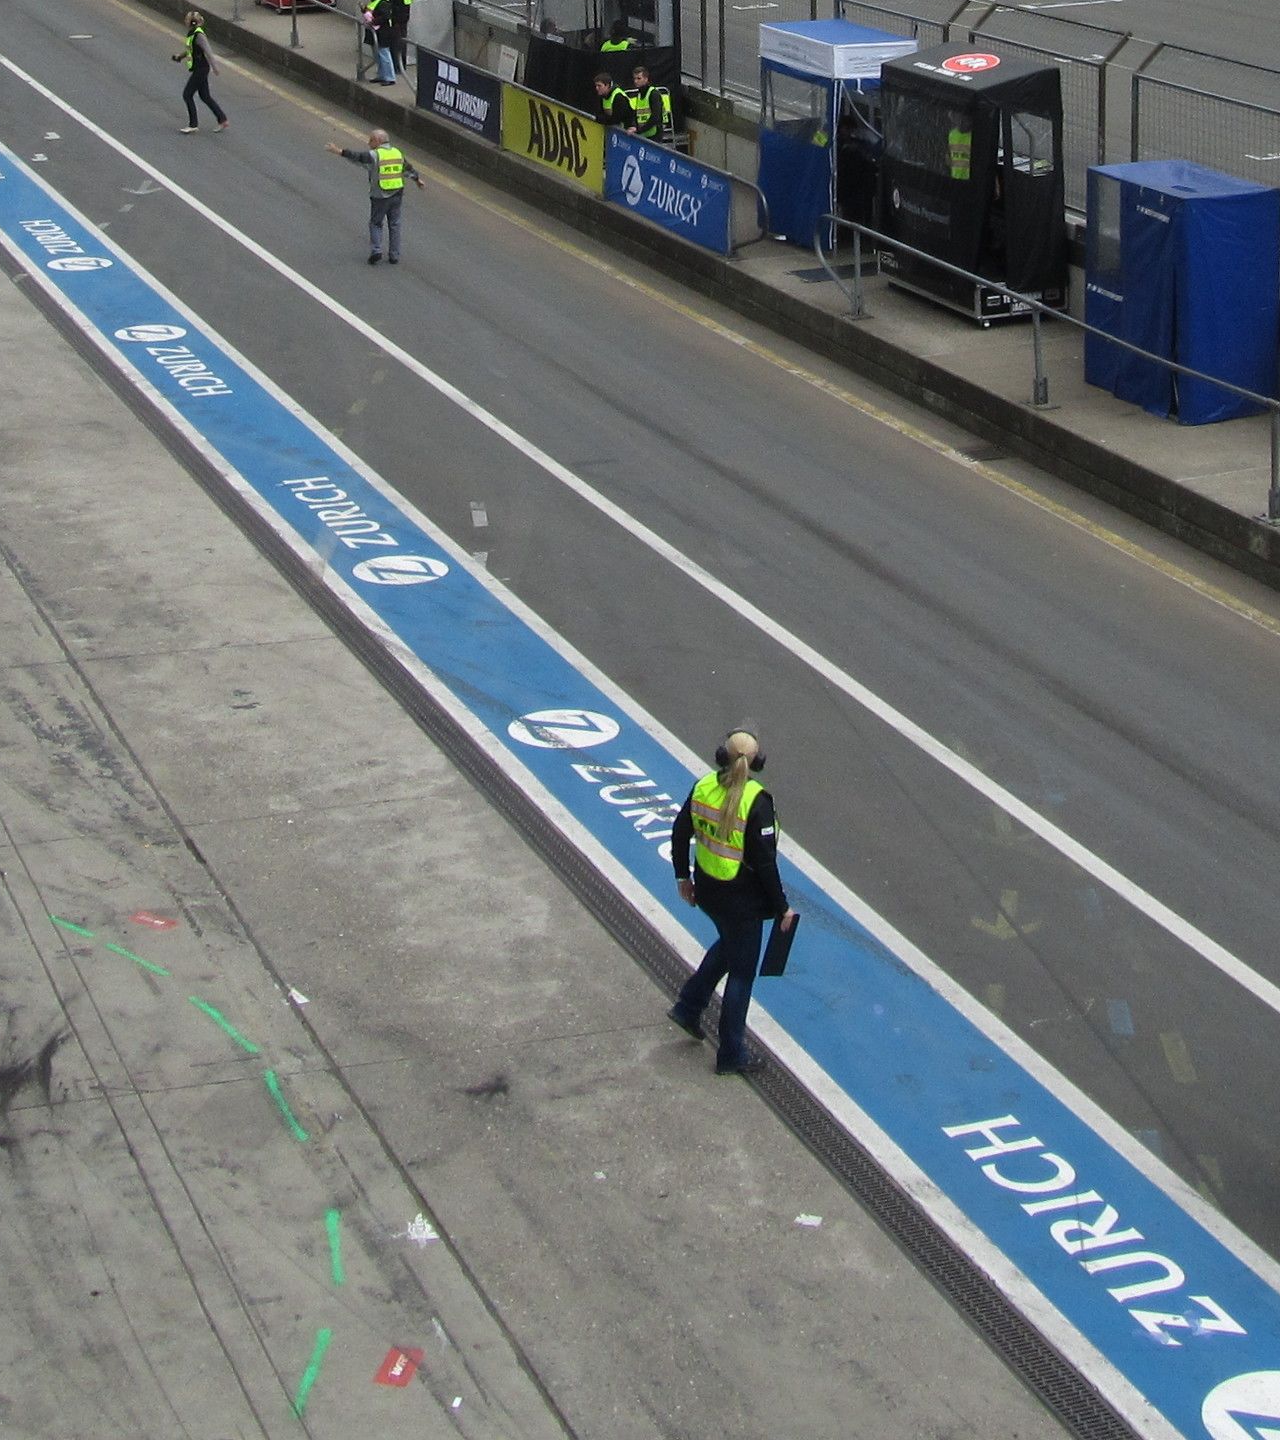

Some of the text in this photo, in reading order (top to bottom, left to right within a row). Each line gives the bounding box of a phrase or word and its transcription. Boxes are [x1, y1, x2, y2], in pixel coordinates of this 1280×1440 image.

[434, 81, 488, 122] GRAN TURISMO
[527, 99, 588, 178] ADAC
[19, 219, 85, 255] ZURICH
[145, 345, 233, 398] ZURICH
[281, 476, 399, 549] ZURICH
[570, 759, 683, 863] ZURI
[941, 1113, 1248, 1346] ZURICH
